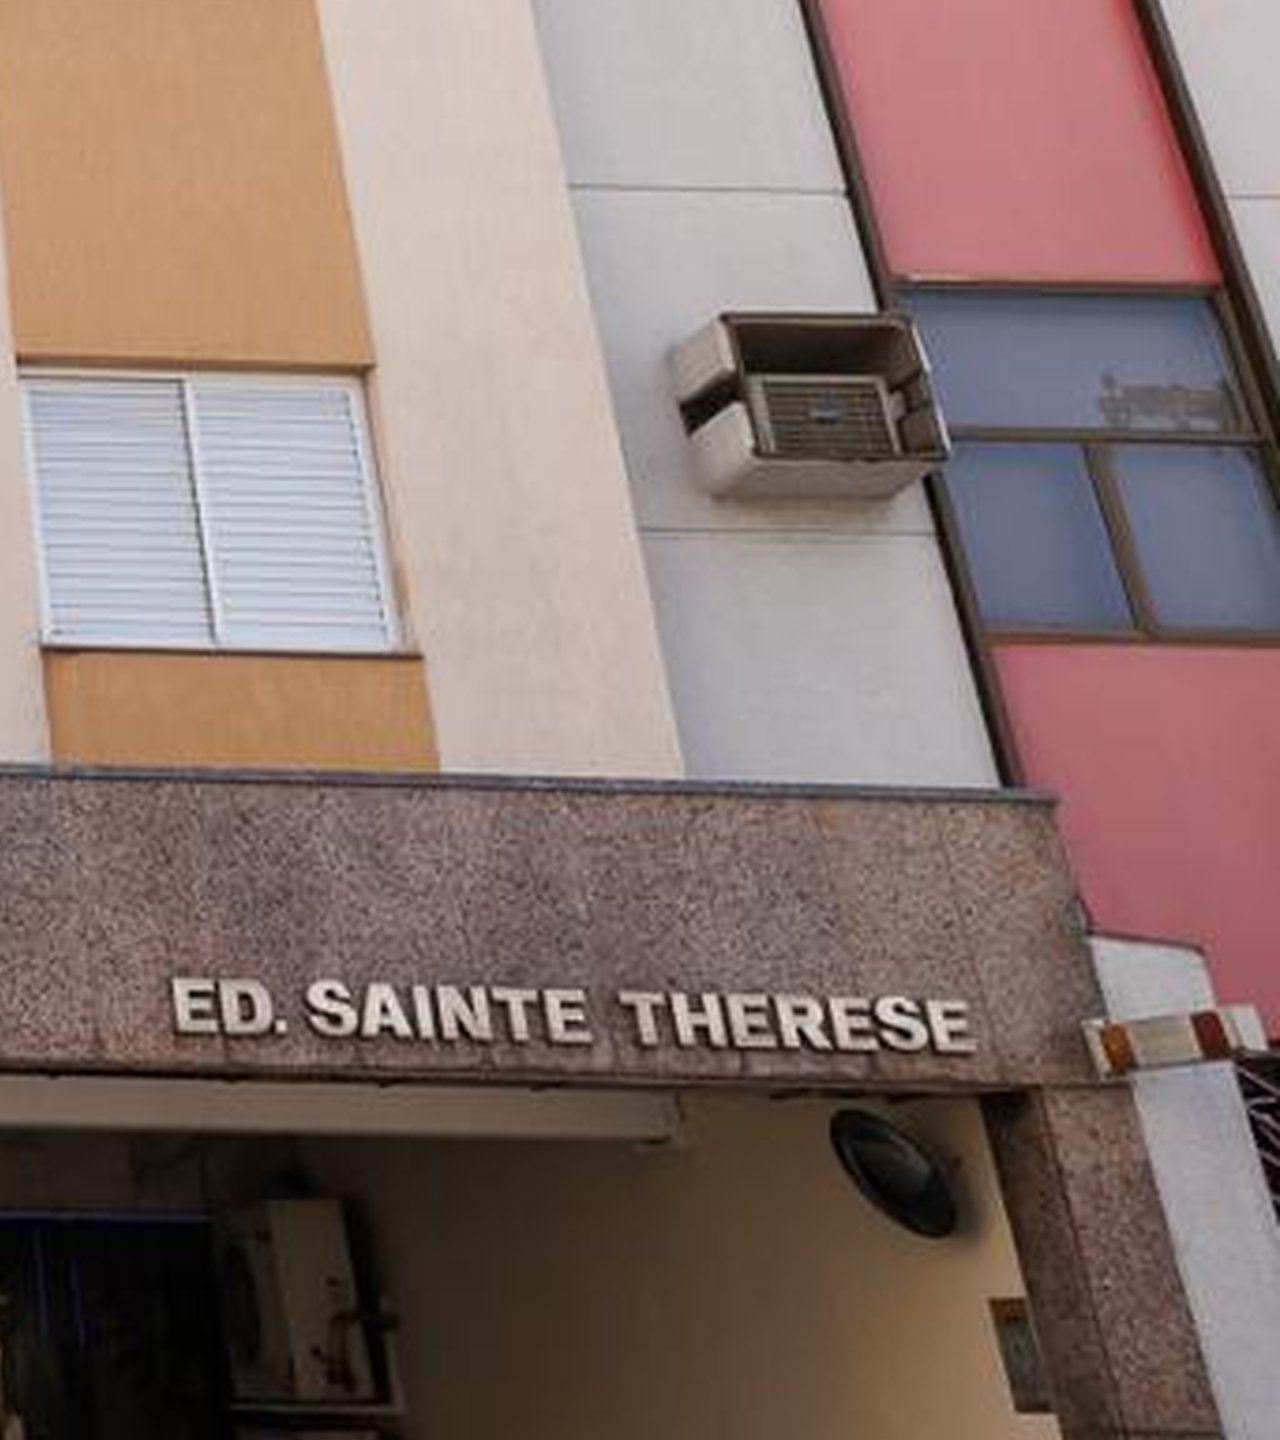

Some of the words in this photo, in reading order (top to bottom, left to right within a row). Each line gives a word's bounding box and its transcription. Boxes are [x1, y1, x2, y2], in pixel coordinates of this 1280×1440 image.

[172, 977, 287, 1034] ED.
[306, 978, 593, 1044] SAINTE
[619, 990, 978, 1053] THERESE
